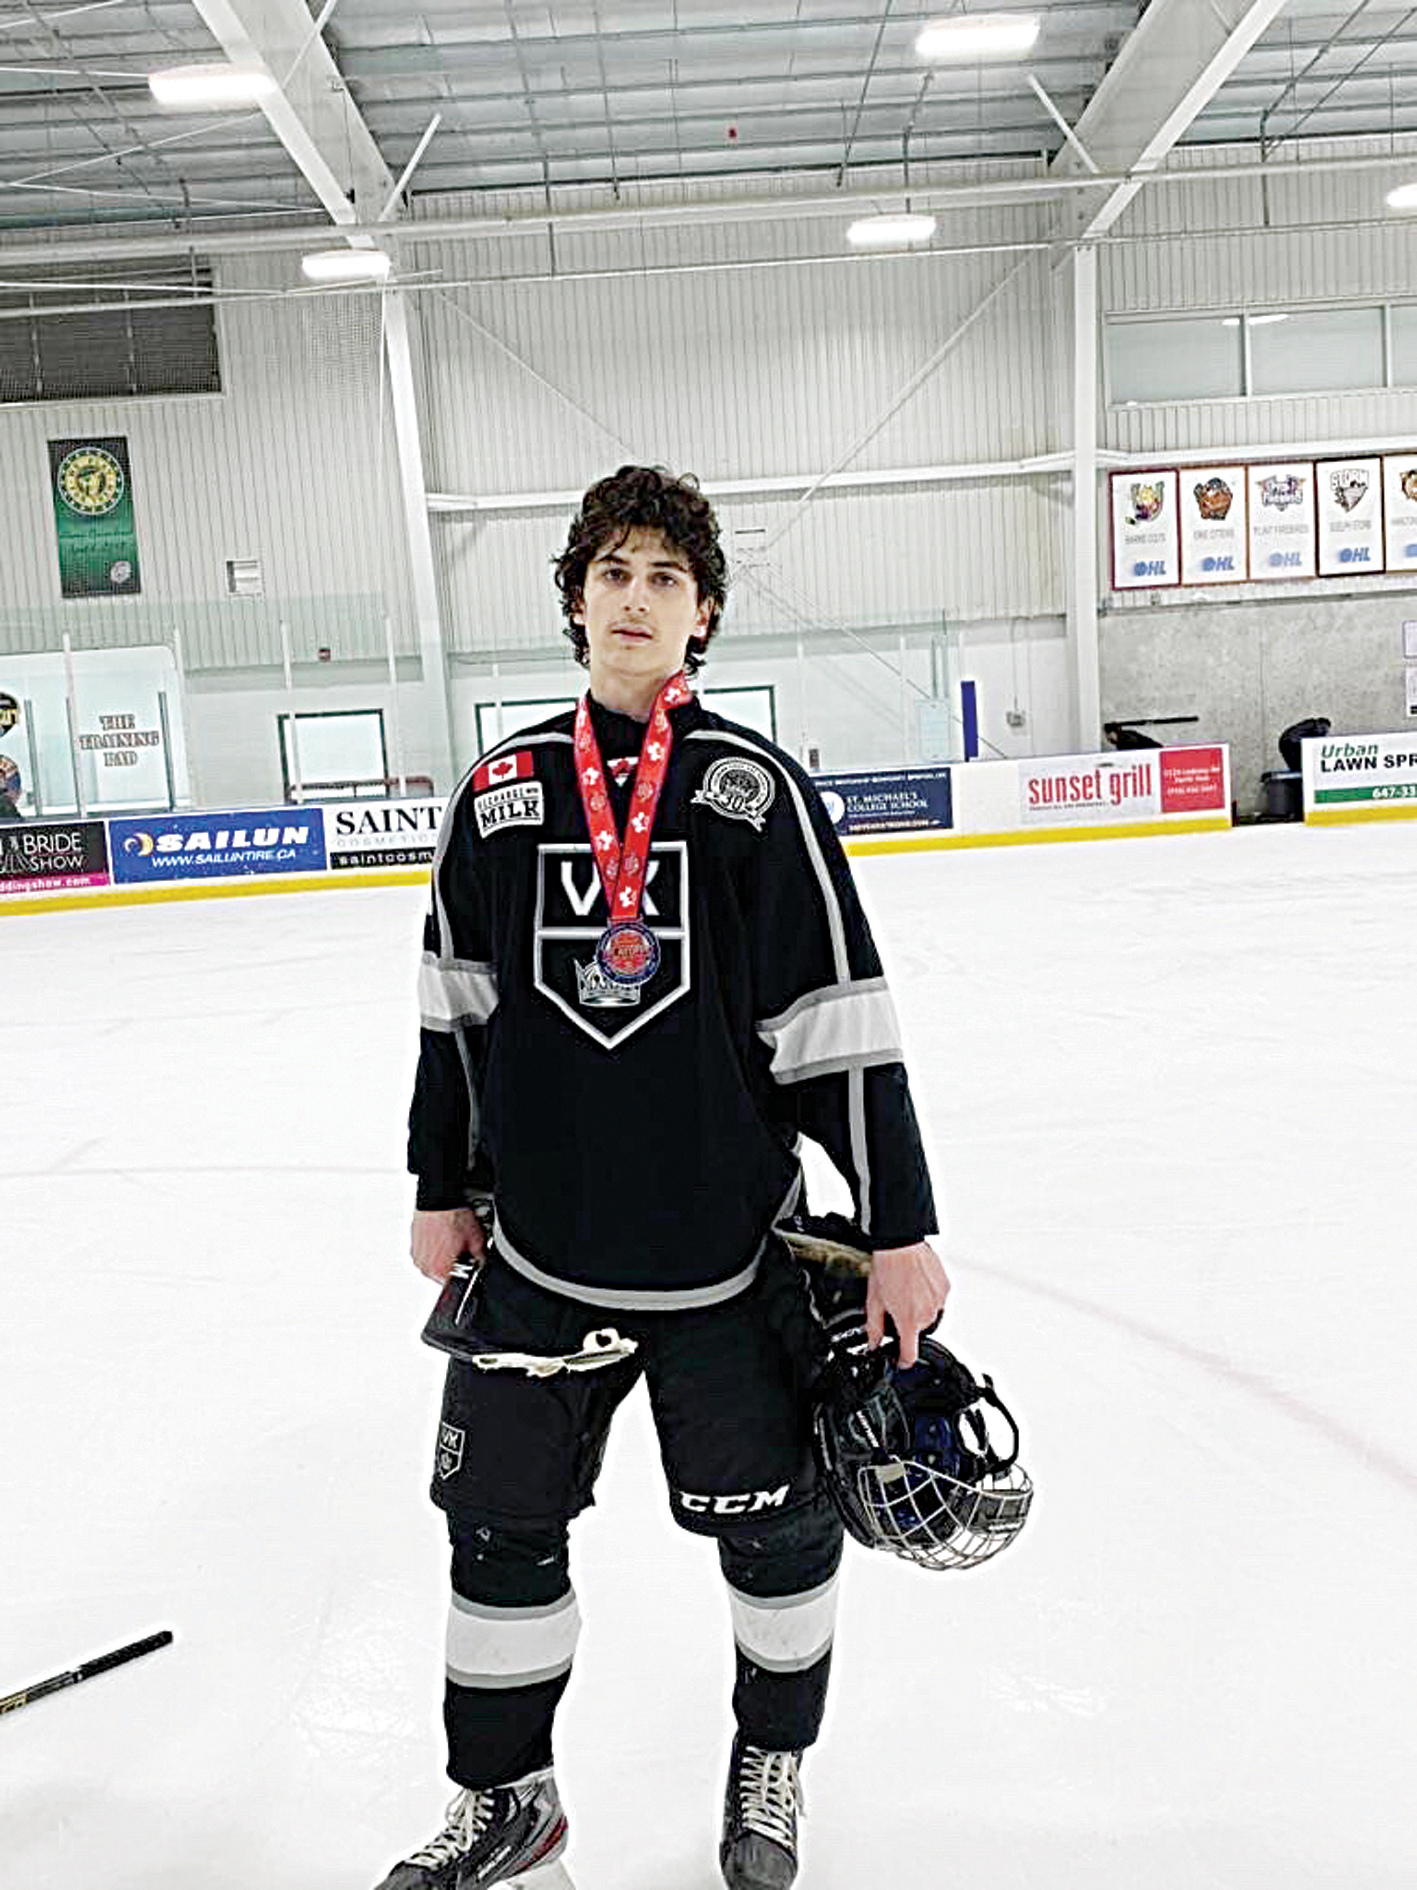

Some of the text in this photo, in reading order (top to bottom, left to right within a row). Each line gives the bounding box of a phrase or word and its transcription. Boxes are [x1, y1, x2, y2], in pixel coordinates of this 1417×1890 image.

[1330, 468, 1370, 490] STORM
[99, 713, 135, 731] THE
[79, 730, 160, 750] TRAINING
[103, 751, 138, 767] PAD
[1321, 743, 1378, 758] Urban
[1321, 756, 1377, 772] LAWN
[1029, 764, 1152, 806] sunset grill
[481, 800, 540, 828] MILK
[890, 799, 929, 810] SCHOOL
[336, 806, 442, 835] SAINT
[24, 832, 82, 855] BRIDE
[156, 826, 309, 852] SAILUN
[30, 855, 85, 871] SHOW
[152, 849, 296, 867] WWW.SAILUNTIRE.CA
[680, 1484, 790, 1514] CCM
